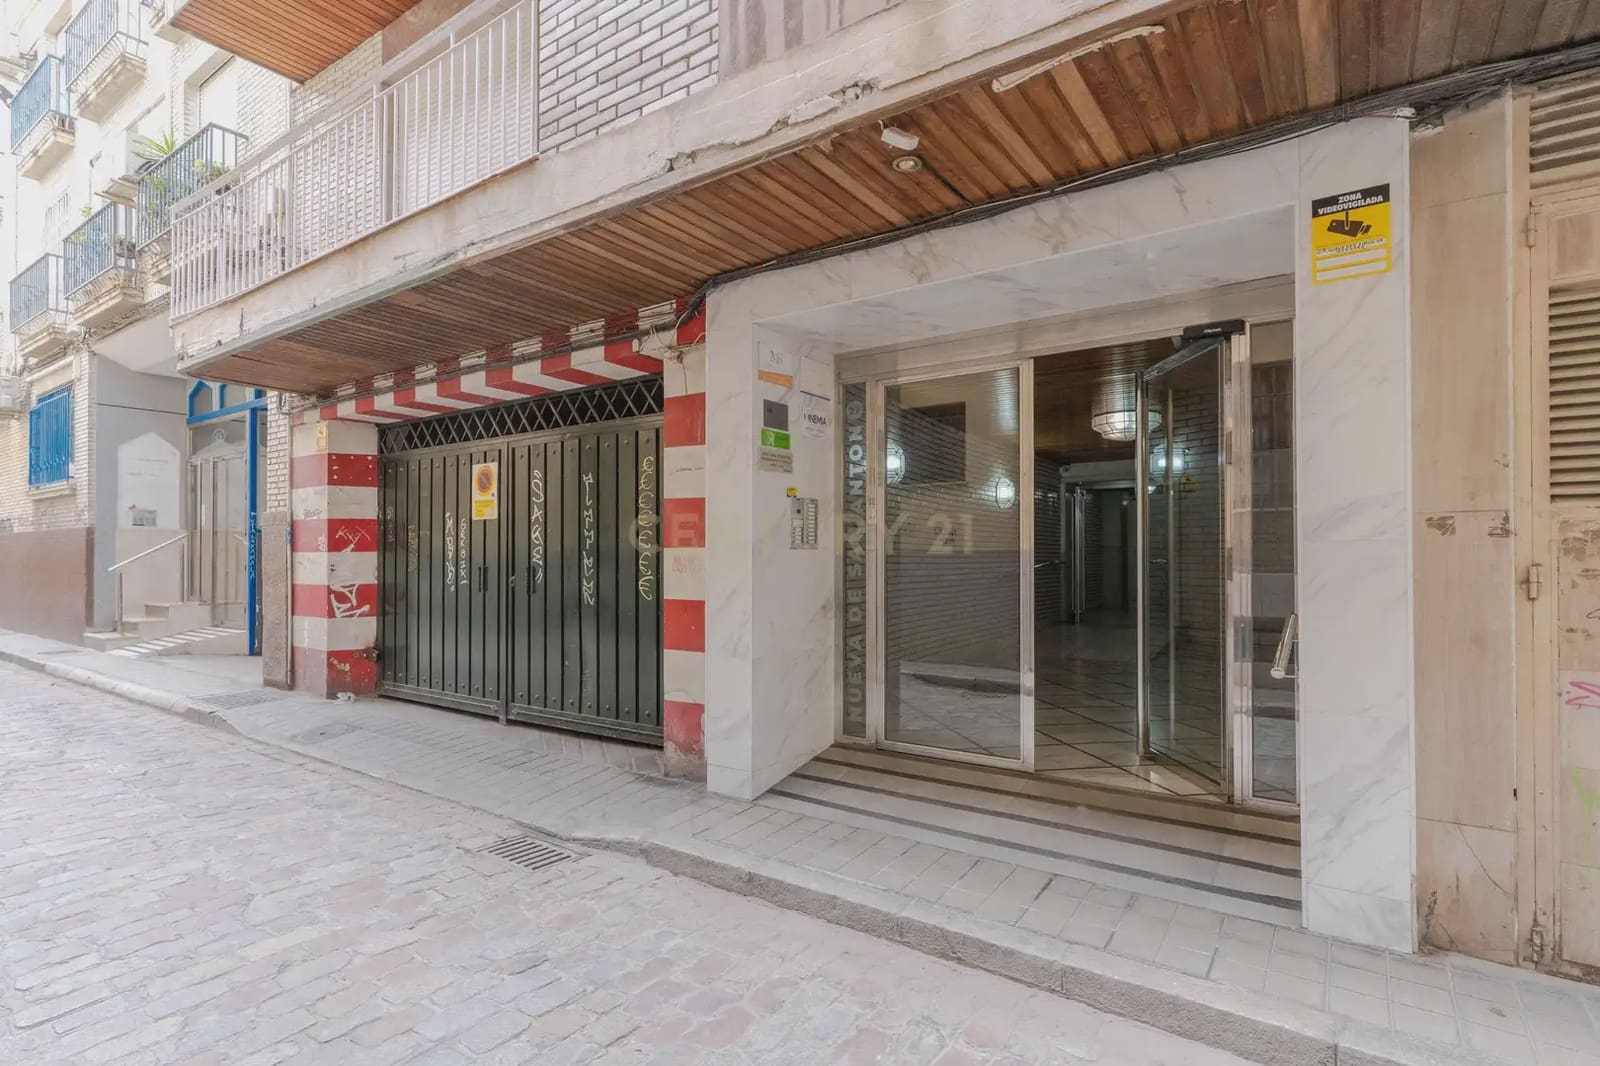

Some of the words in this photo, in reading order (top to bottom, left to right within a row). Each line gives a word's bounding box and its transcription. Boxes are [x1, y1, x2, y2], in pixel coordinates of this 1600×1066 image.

[1317, 195, 1384, 215] VIDEOVIGILADA
[1337, 192, 1362, 203] ZONA
[847, 588, 863, 623] DE
[846, 636, 863, 722] NUEVA
